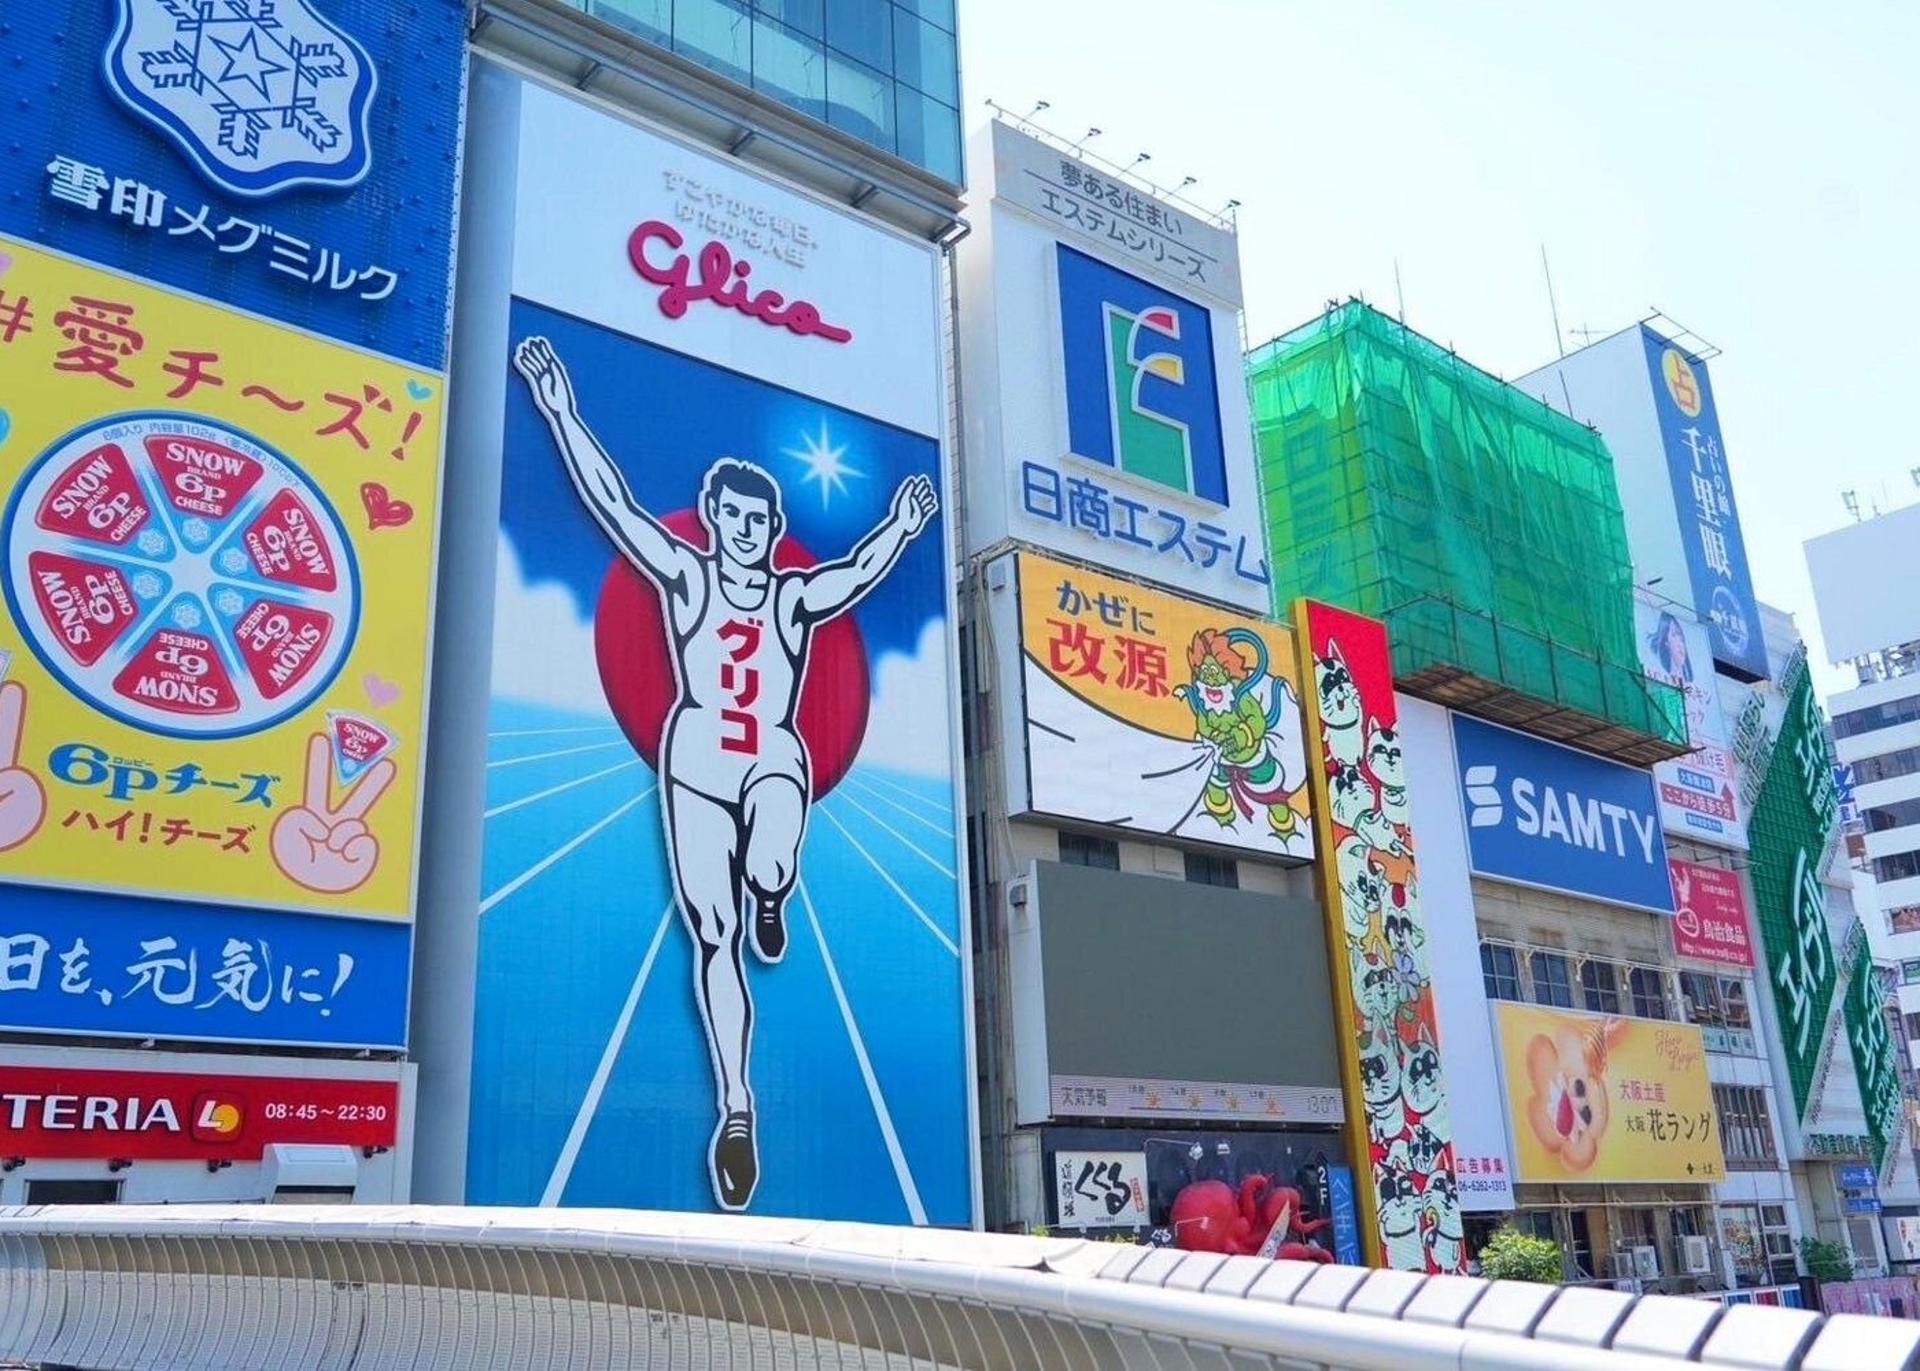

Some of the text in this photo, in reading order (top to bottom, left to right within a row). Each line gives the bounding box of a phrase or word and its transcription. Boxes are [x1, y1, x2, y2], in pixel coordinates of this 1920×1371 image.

[1060, 160, 1183, 236] 夢ある住まい
[47, 154, 398, 301] 雪印メグミルク
[1042, 187, 1206, 283] エステムシリーズ
[628, 220, 851, 343] Glico
[1671, 352, 1697, 411] 占
[52, 454, 114, 519] SNOW
[166, 442, 246, 477] SNOW
[110, 505, 147, 541] CHEESE
[175, 495, 223, 516] CHEESE
[1022, 460, 1272, 585] 日商エステム
[1681, 426, 1733, 581] 千里眼
[246, 532, 274, 576] CHEESE
[282, 508, 330, 574] SNOW
[37, 570, 92, 645] SNOW
[104, 569, 134, 615] CHEESE
[1056, 580, 1156, 636] かぜに
[159, 632, 209, 651] CHEESE
[236, 602, 270, 639] CHEESE
[268, 622, 321, 687] SNOW
[1046, 618, 1173, 698] 改源
[133, 675, 219, 707] SNOW
[716, 617, 764, 756] グリコ
[62, 809, 257, 854] ハイ!チーズ
[1511, 776, 1655, 864] SAMTY
[1778, 846, 1826, 1060] エイブル
[2, 1094, 181, 1131] TERIA
[265, 1103, 387, 1122] 08:45～22:30
[1619, 1079, 1666, 1103] 大阪土産
[1075, 1160, 1132, 1216] くくる
[1317, 1166, 1328, 1206] 2F
[1456, 1157, 1504, 1174] 広告募集
